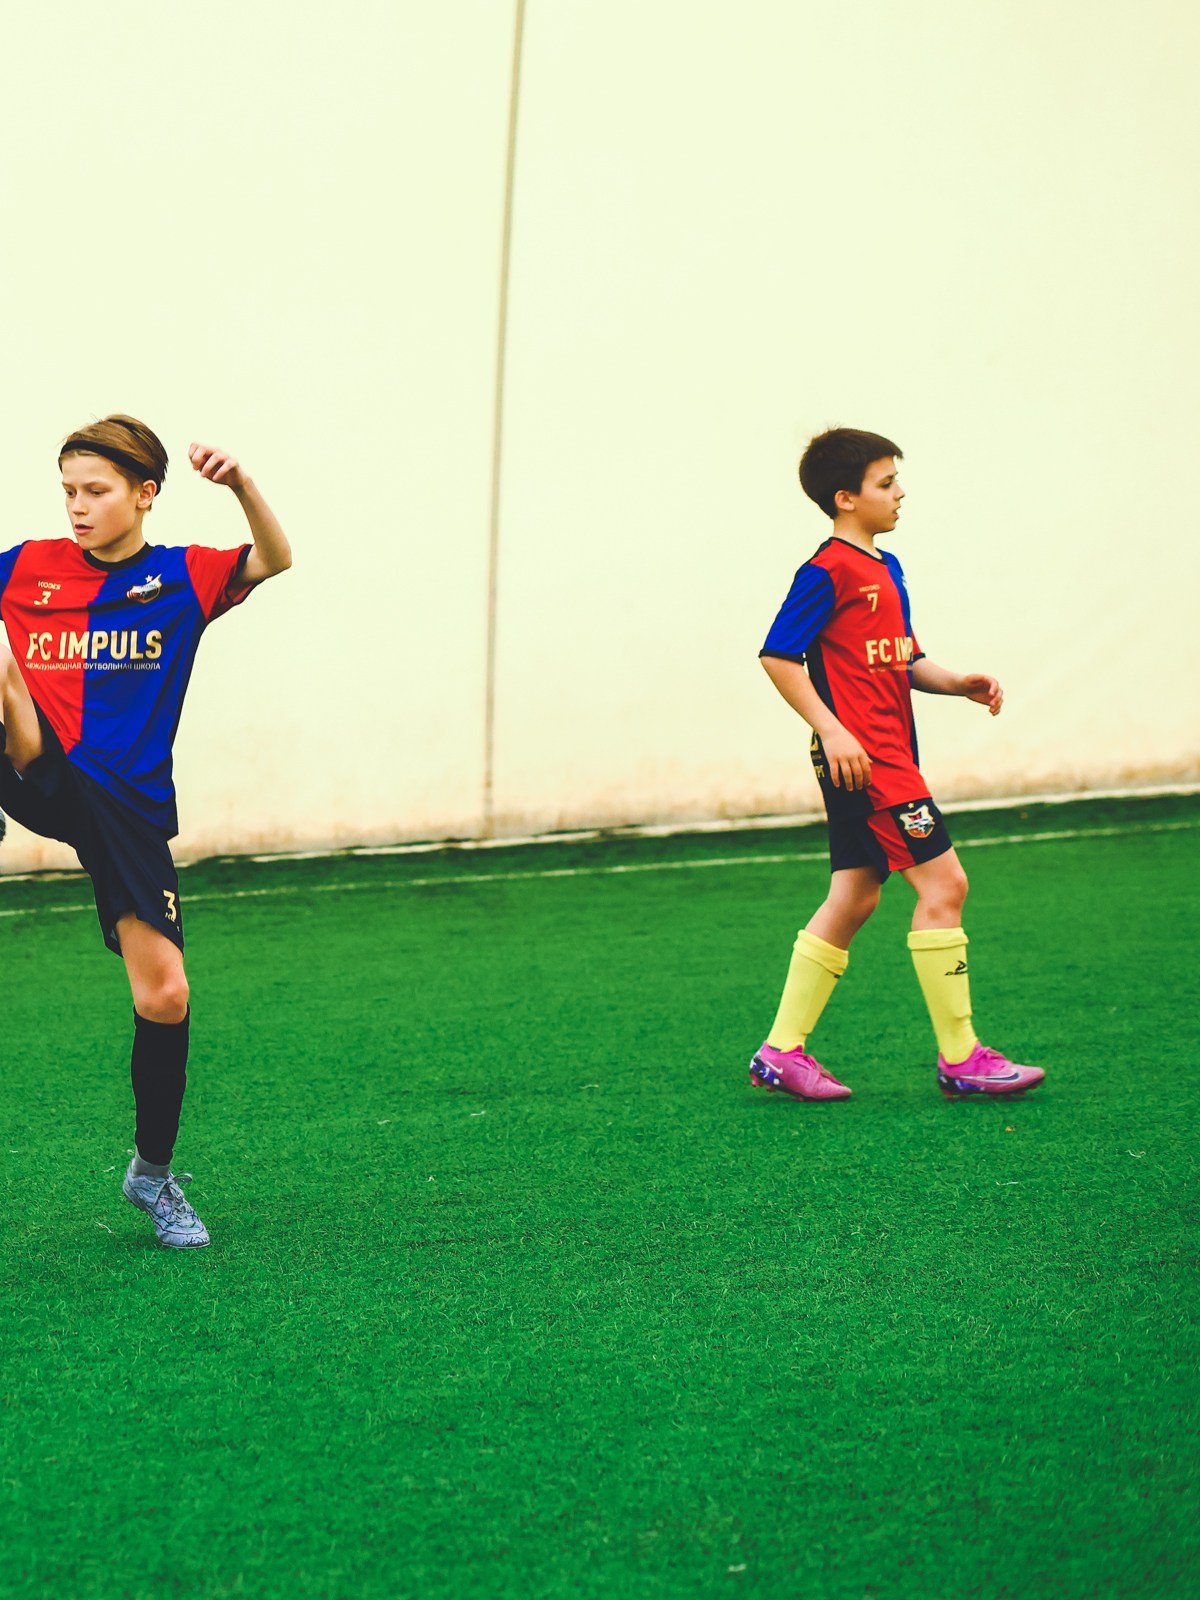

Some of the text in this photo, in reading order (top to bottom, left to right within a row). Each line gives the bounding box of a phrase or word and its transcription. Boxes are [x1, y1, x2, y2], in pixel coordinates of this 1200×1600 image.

[867, 593, 878, 612] 7
[26, 629, 162, 661] FC IMPULS
[866, 638, 892, 666] FC
[83, 662, 131, 670] ФУТБОЛЬНАЯ
[134, 662, 160, 670] ШКОЛА
[163, 889, 177, 921] 3
